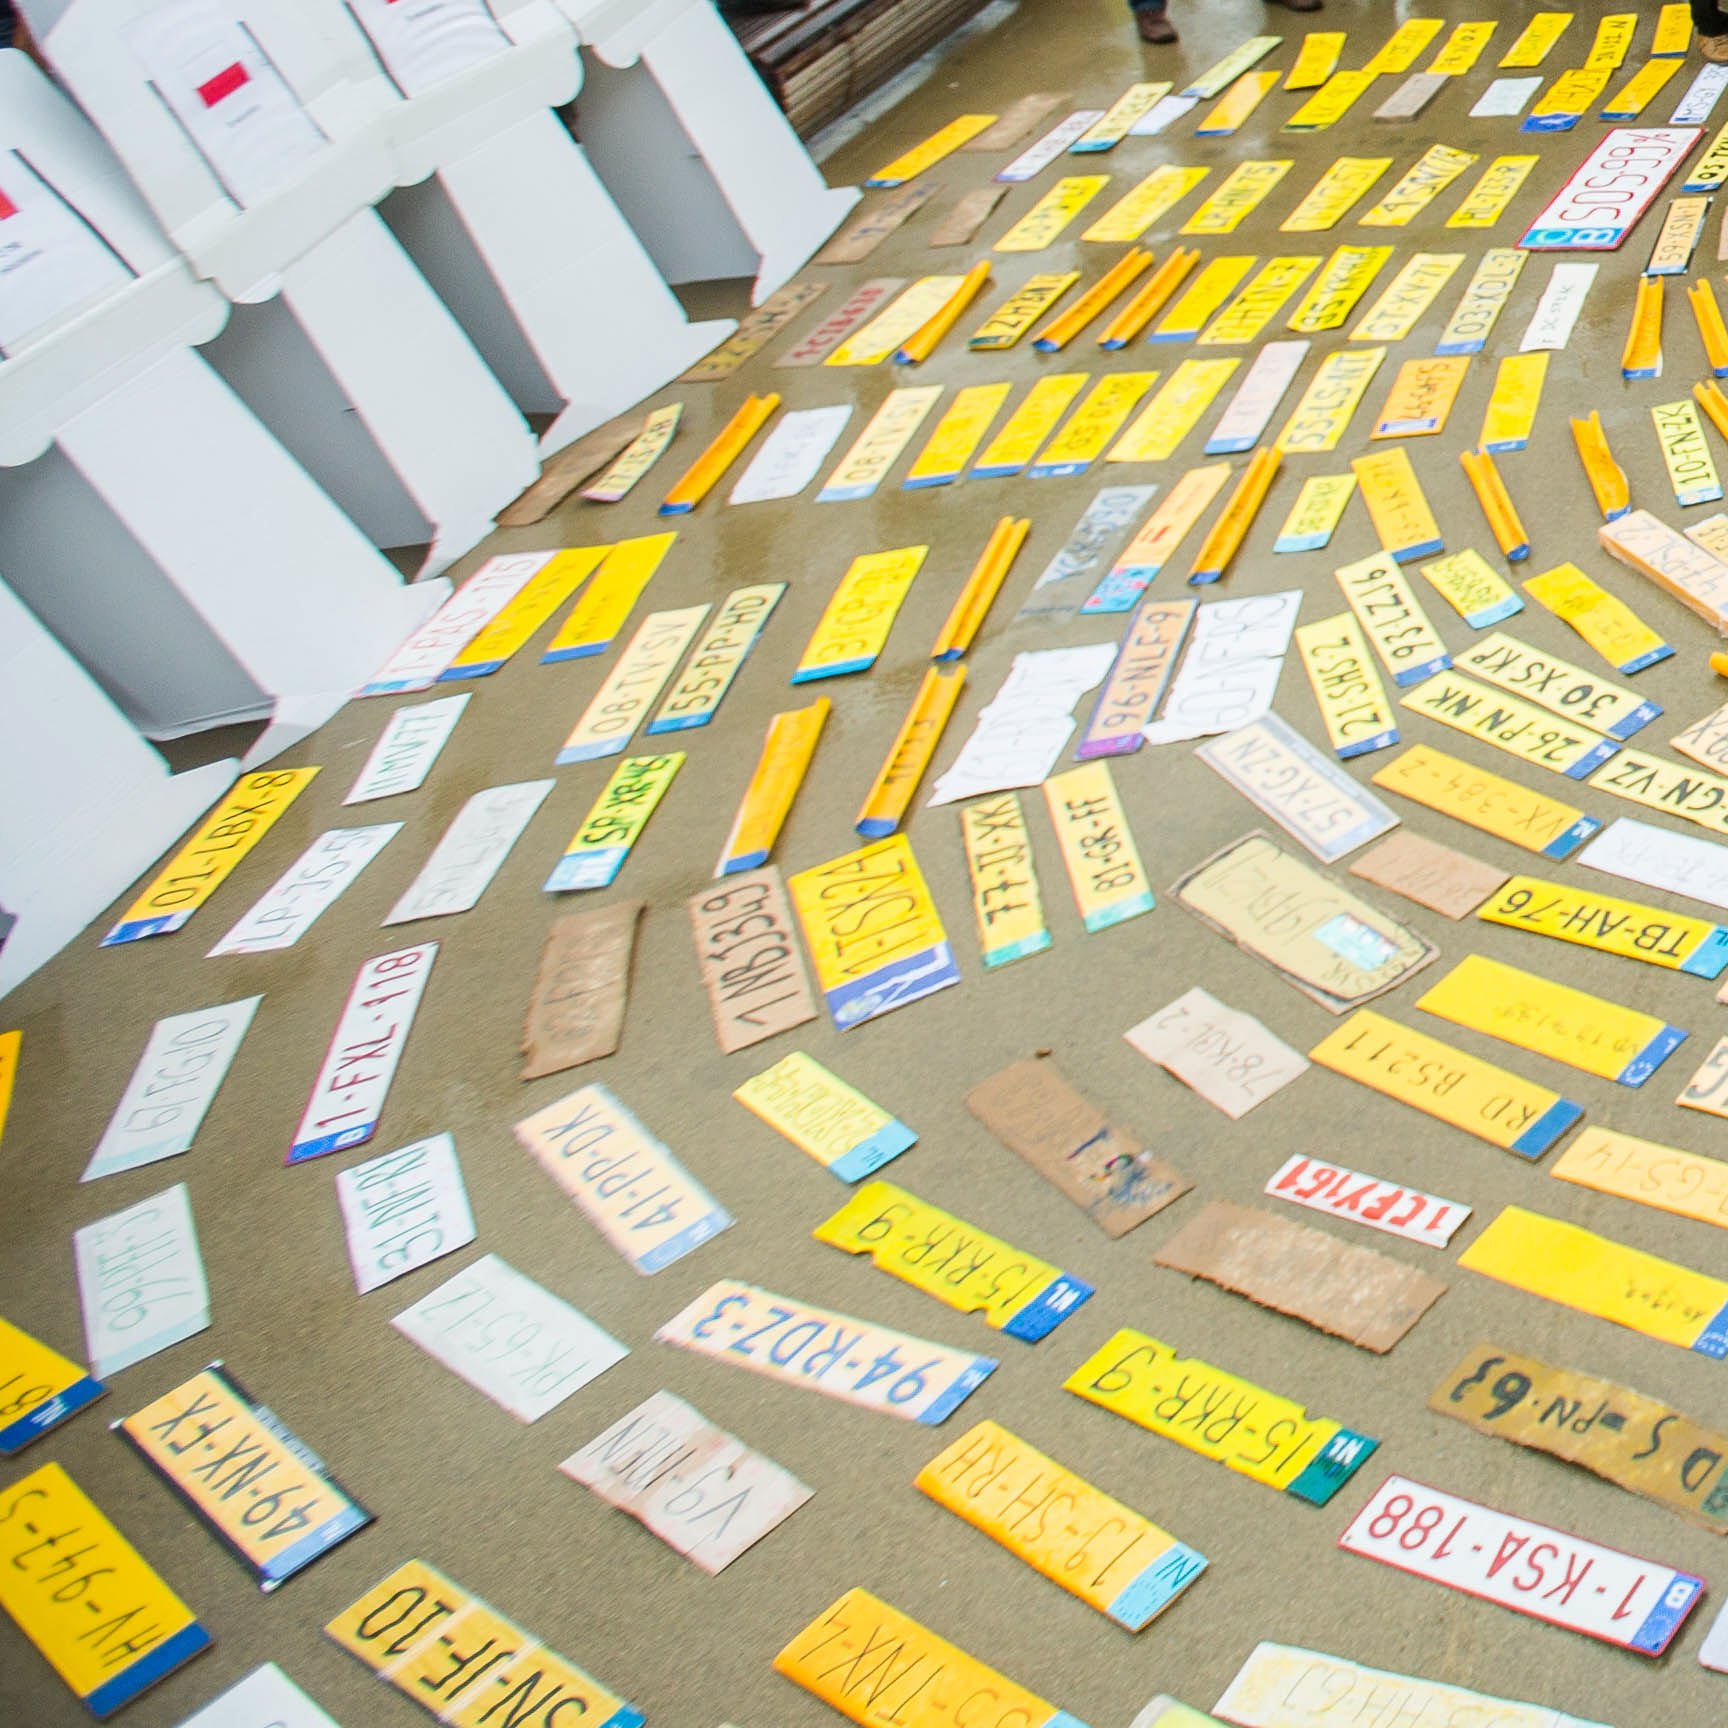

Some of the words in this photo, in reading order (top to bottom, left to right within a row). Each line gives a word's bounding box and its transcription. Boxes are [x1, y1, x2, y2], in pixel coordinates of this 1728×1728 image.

[144, 769, 305, 910] 01-LBX-8
[1492, 885, 1700, 961] TB-AH-76
[306, 947, 426, 1133] 1-FXL-118
[855, 1203, 1036, 1312] 15-RKR-9
[1043, 1283, 1077, 1313] NL
[677, 1287, 953, 1408] 94-RDZ-3
[155, 1389, 331, 1545] 49-NX-FX
[1089, 1345, 1312, 1477] 15-RKR-9
[1327, 1433, 1362, 1467] NL
[1366, 1492, 1648, 1623] 1-KSA-188
[1669, 1579, 1693, 1611] B
